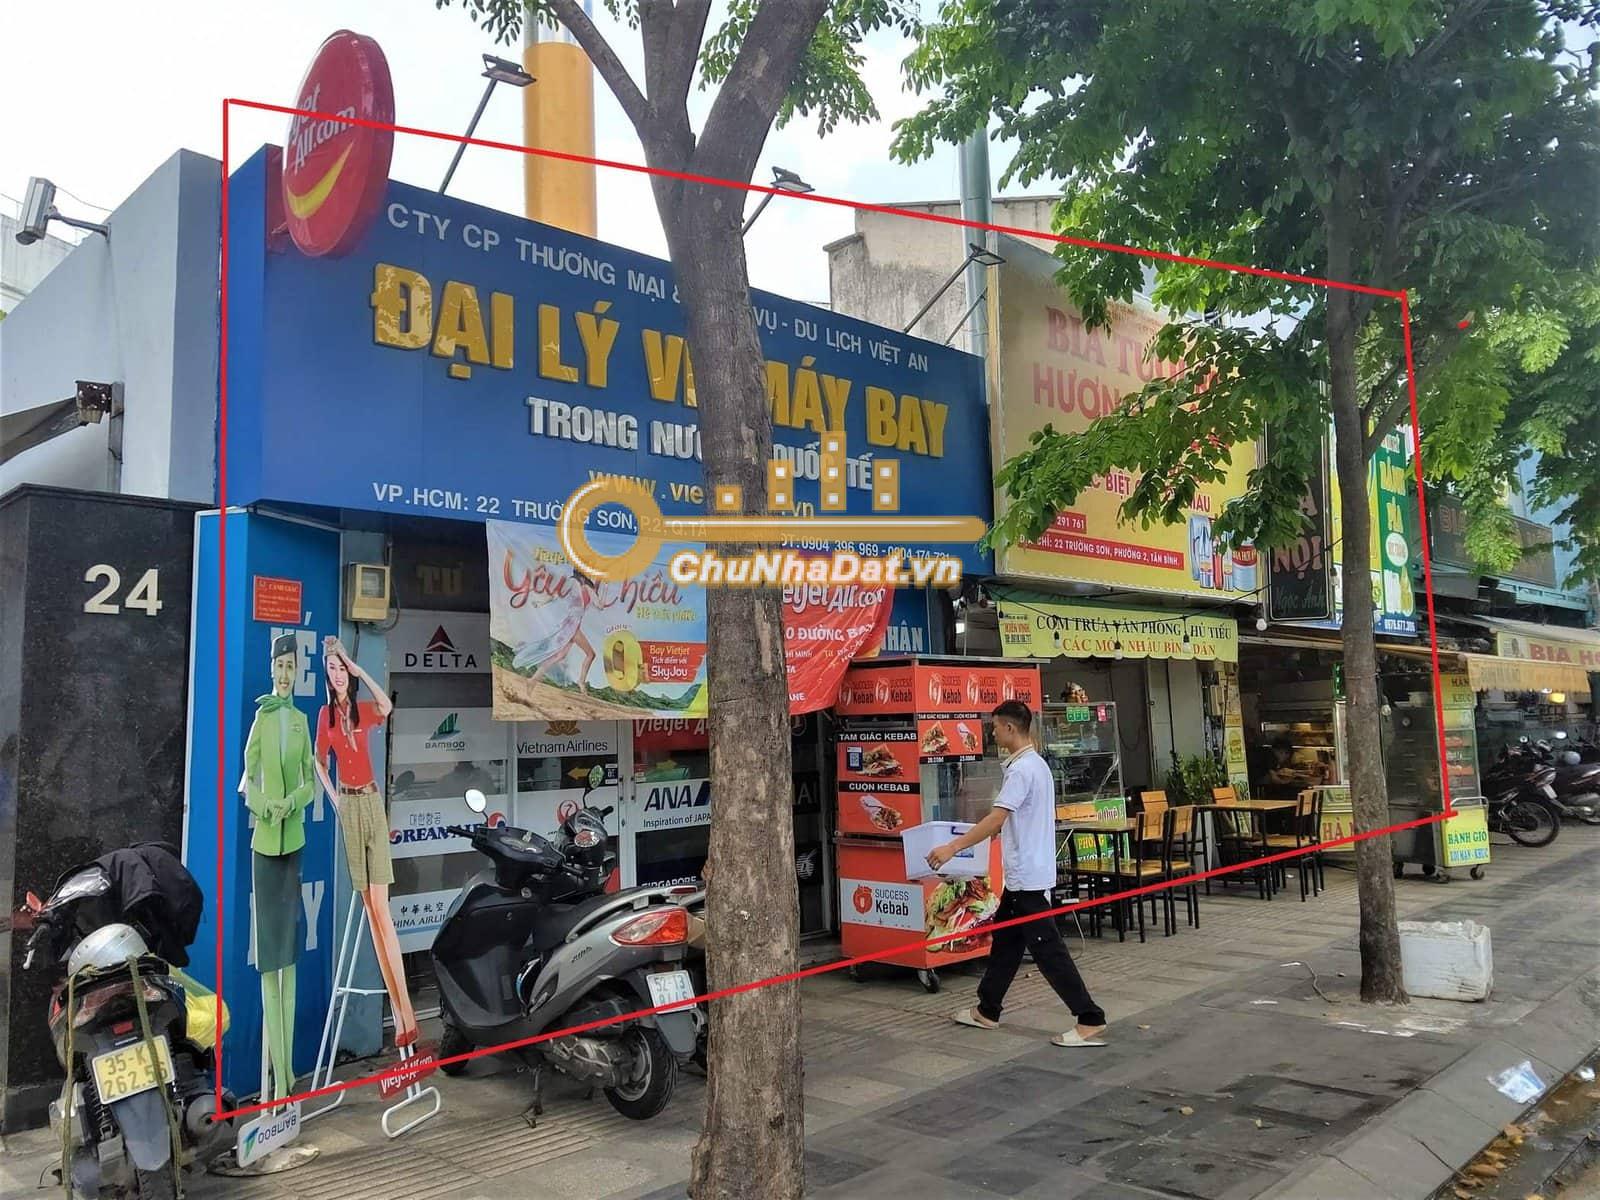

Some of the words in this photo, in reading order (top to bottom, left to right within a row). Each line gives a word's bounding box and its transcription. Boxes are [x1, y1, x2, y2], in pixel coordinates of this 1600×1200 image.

[387, 203, 451, 241] CTY
[463, 224, 500, 251] CP
[515, 237, 615, 286] THƯƠNG
[628, 270, 665, 303] MẠI
[794, 319, 818, 341] DU
[825, 330, 861, 356] LỊCH
[869, 339, 900, 371] VIỆT
[908, 353, 928, 373] AN
[370, 262, 514, 379] ĐẠI
[538, 301, 620, 389] LÝ
[865, 385, 948, 458] BAY
[526, 396, 639, 450] TRONG
[847, 452, 873, 490] TẾ
[1106, 470, 1131, 499] BIỆT
[476, 496, 500, 515] 22
[597, 509, 638, 533] SƠN,
[834, 539, 855, 555] 396
[858, 542, 879, 557] 969
[1054, 539, 1064, 549] 22
[1065, 538, 1095, 553] TRƯỜNG
[83, 564, 163, 616] 24
[1062, 635, 1092, 651] CÁC
[1193, 641, 1216, 656] DÂN
[405, 653, 477, 668] DELTA
[425, 741, 465, 749] BAMBOO
[840, 733, 857, 741] TAM
[860, 731, 882, 741] GIÁC
[884, 732, 917, 740] KEBAB
[516, 741, 565, 756] Vietnam
[565, 740, 608, 754] Airlines
[849, 783, 875, 792] CUỘN
[877, 783, 910, 792] KEBAB
[644, 785, 692, 812] ANA
[643, 817, 684, 829] Inspiration
[684, 816, 693, 824] of
[874, 888, 909, 901] SUCCESS
[875, 900, 909, 917] Kebab
[105, 1045, 149, 1076] 35-K
[257, 1114, 297, 1144] BAMBOO
